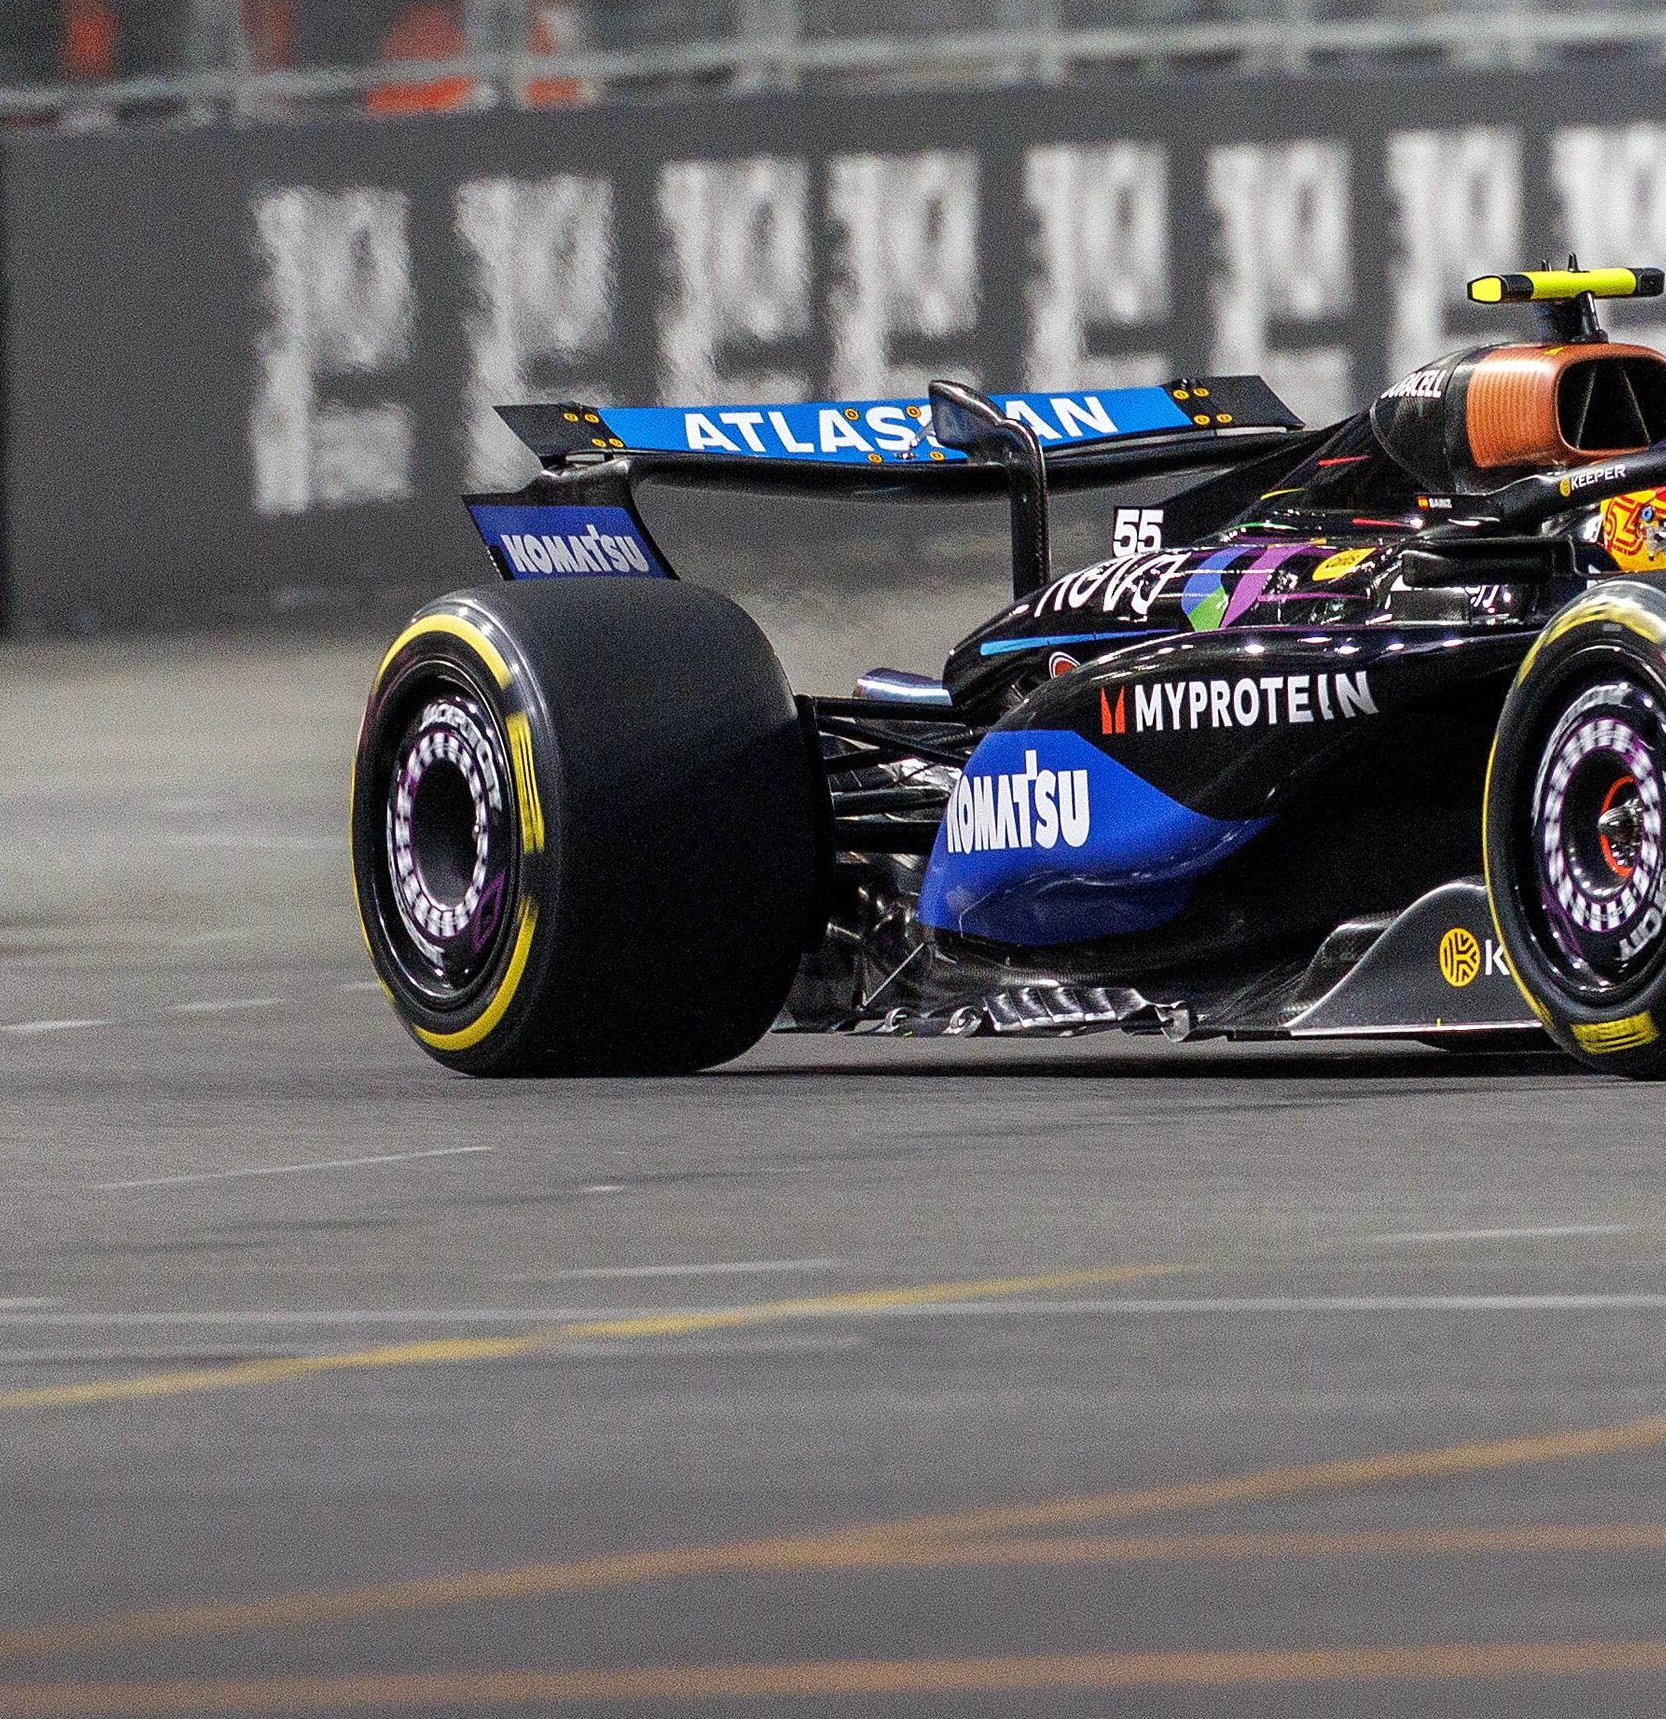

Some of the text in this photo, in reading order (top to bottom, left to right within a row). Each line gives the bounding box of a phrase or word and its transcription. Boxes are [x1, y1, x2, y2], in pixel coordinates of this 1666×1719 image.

[1570, 464, 1626, 490] KEEPER
[500, 524, 649, 573] KOMATSU
[1113, 508, 1163, 556] 55
[1136, 671, 1379, 732] MYPROTEIN
[947, 749, 1091, 855] KOMATSU
